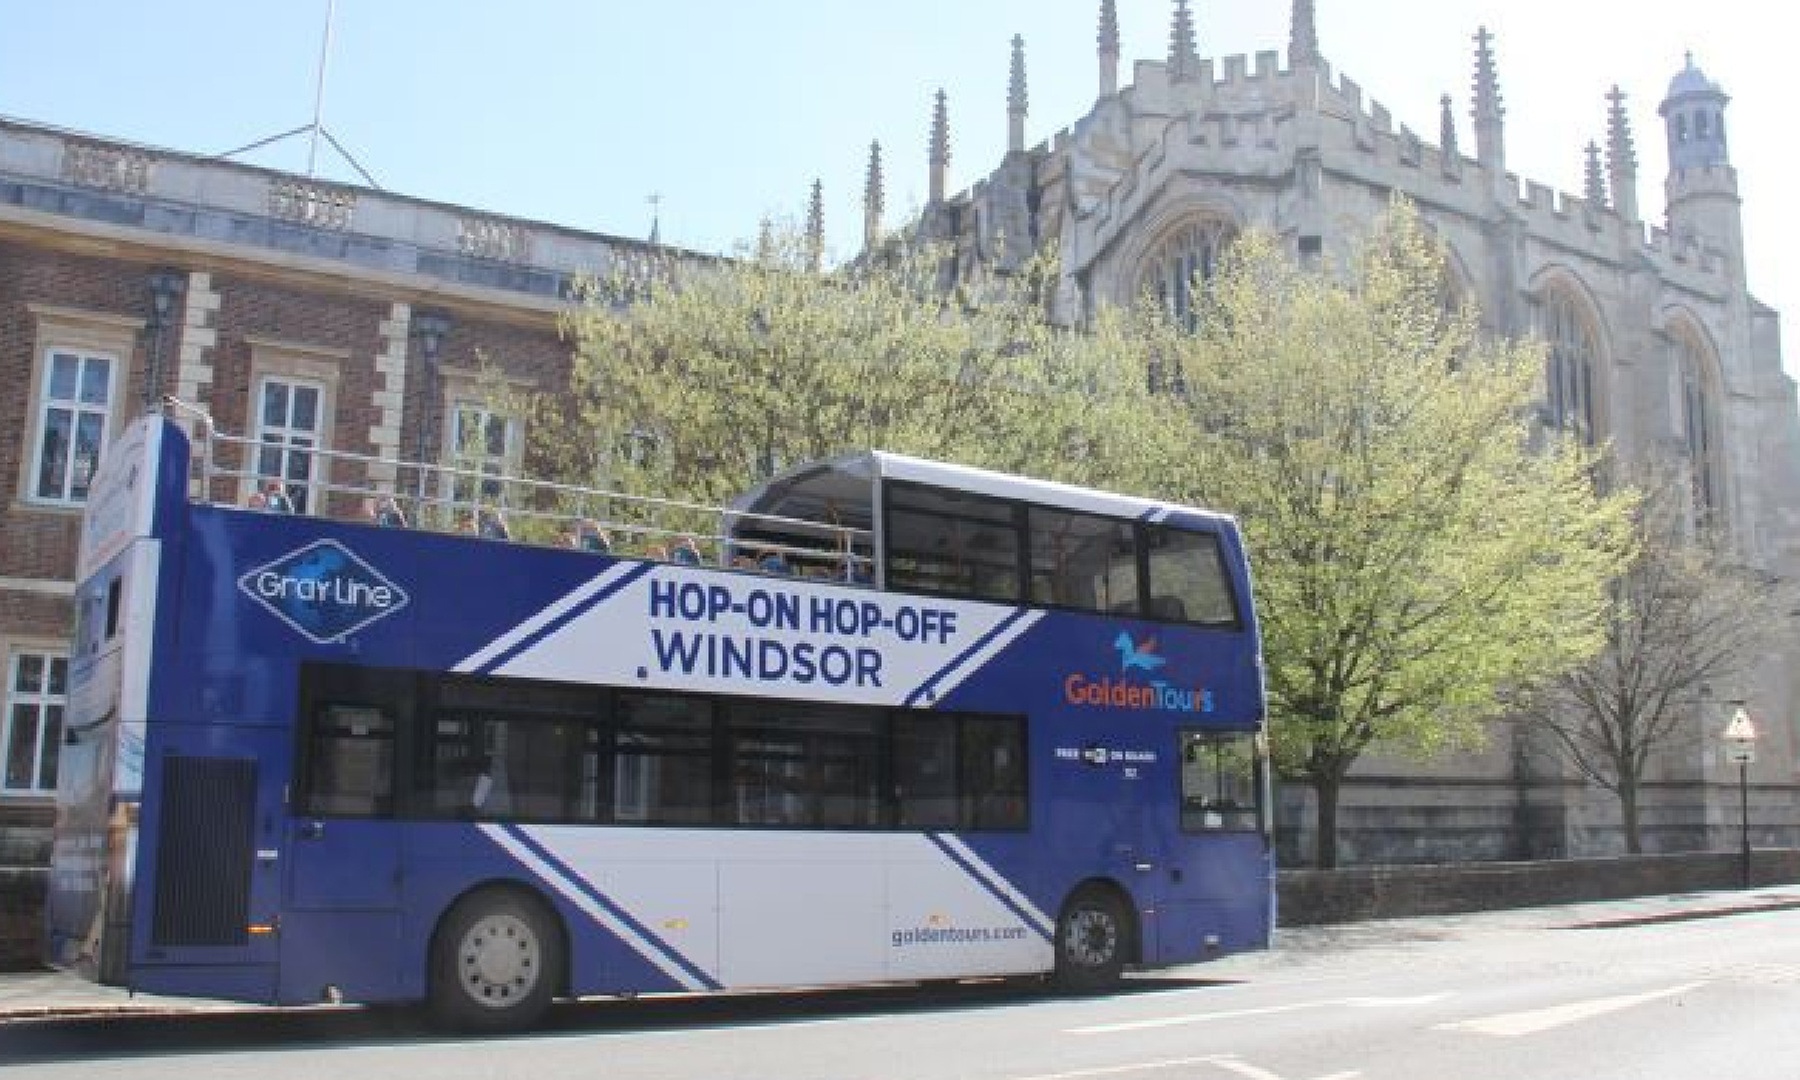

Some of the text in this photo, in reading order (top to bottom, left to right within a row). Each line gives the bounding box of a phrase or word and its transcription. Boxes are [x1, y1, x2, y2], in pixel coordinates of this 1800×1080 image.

[651, 579, 957, 644] HOP-ON HOP-OFF
[651, 629, 883, 687] WINDSOR
